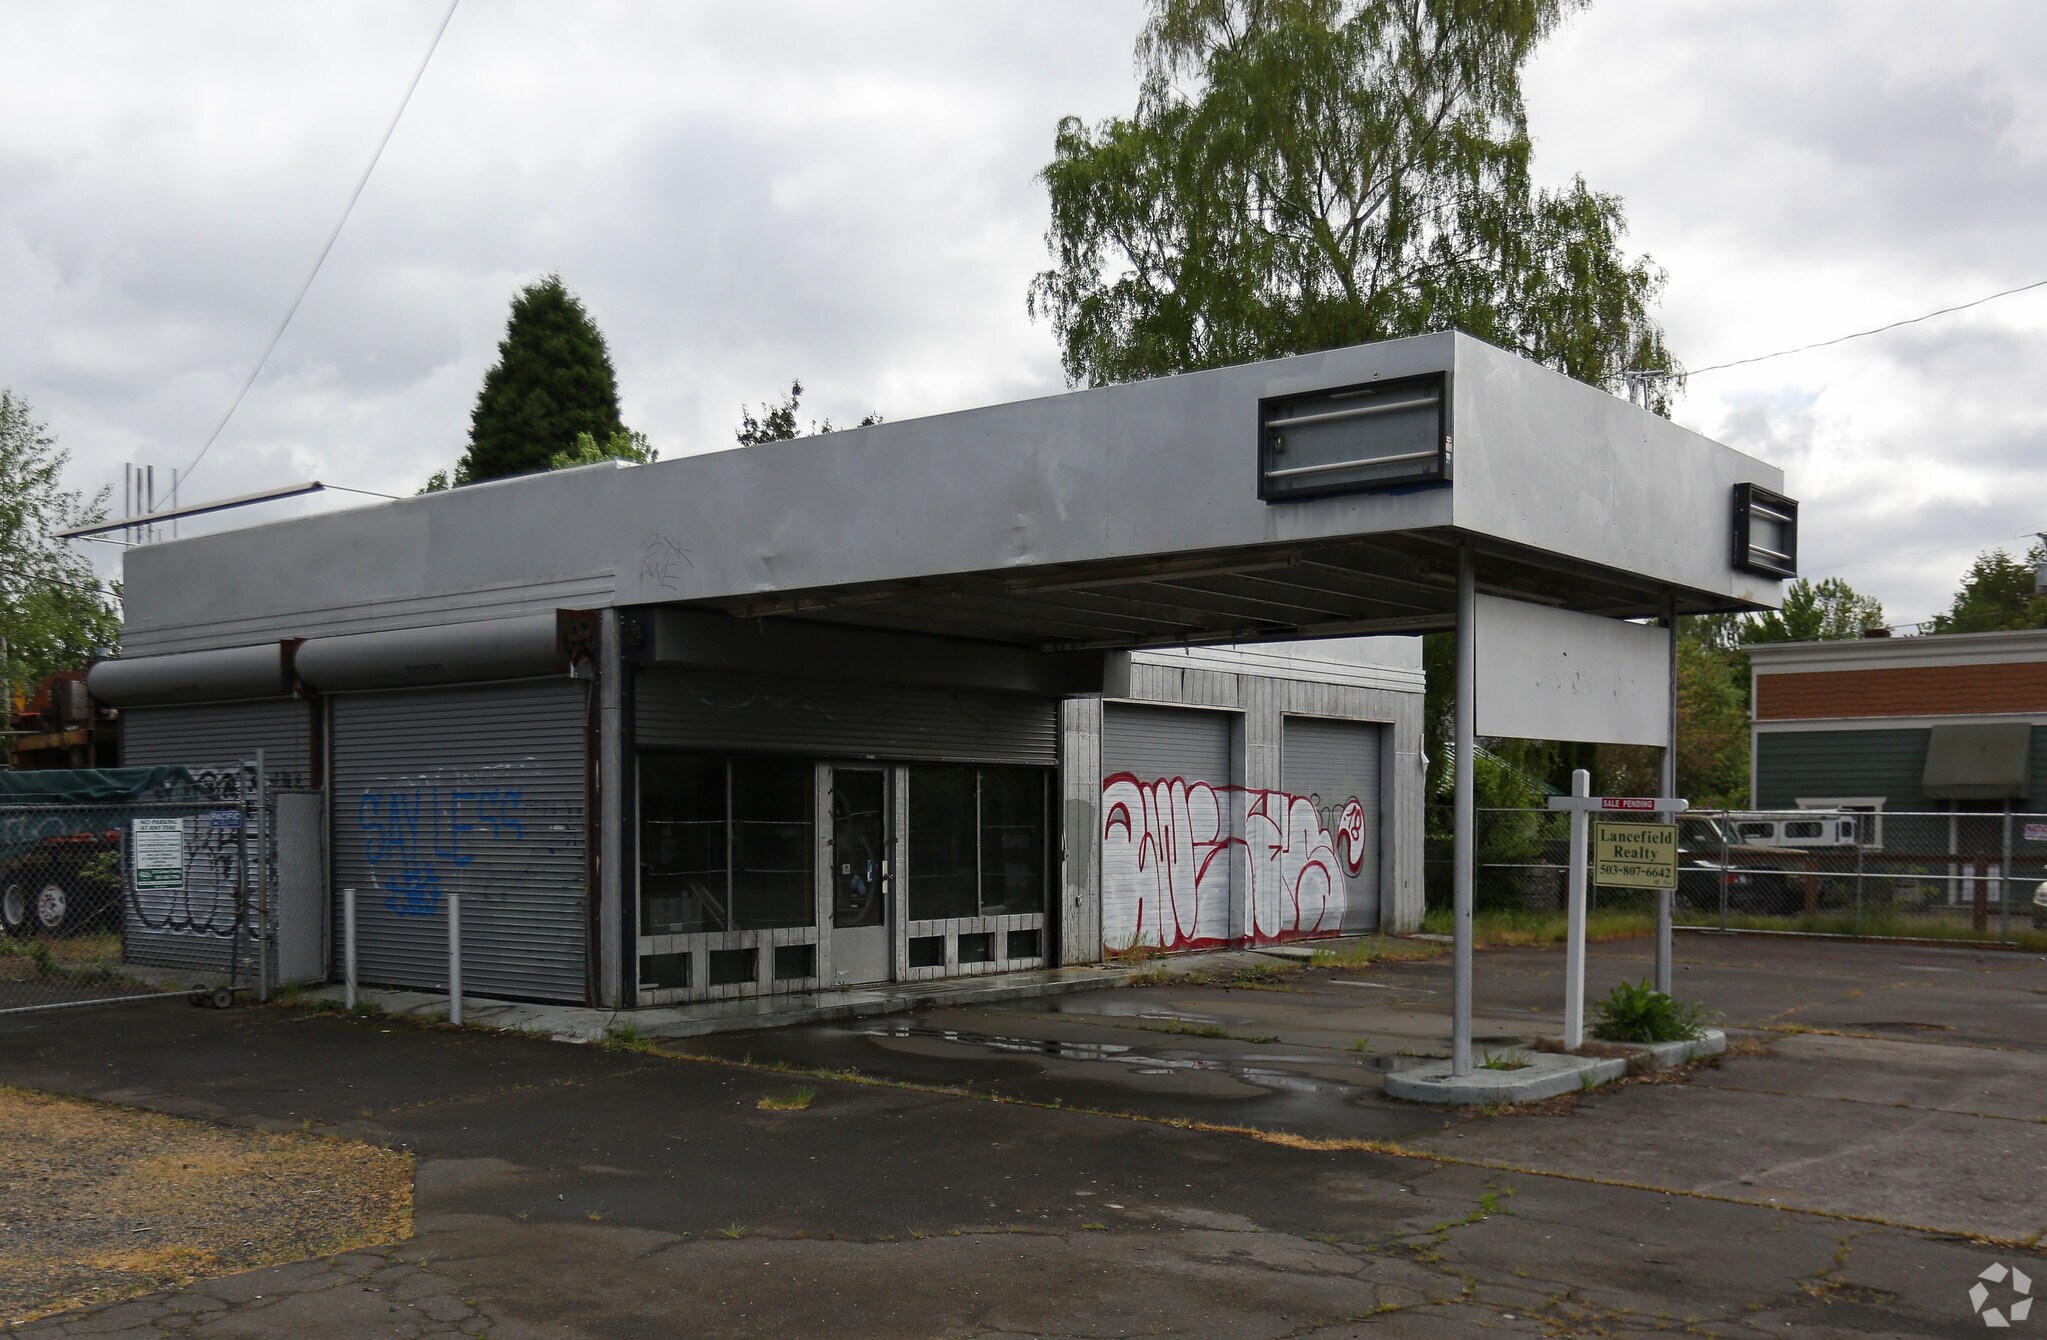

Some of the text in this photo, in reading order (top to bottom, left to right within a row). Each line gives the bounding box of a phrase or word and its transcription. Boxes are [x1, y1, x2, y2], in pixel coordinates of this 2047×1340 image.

[1603, 800, 1653, 808] SALE PENDING
[212, 812, 240, 821] PACIFIC
[1600, 829, 1672, 844] Lancefield
[1614, 845, 1658, 862] Realty
[1599, 864, 1671, 878] 503-807-6642
